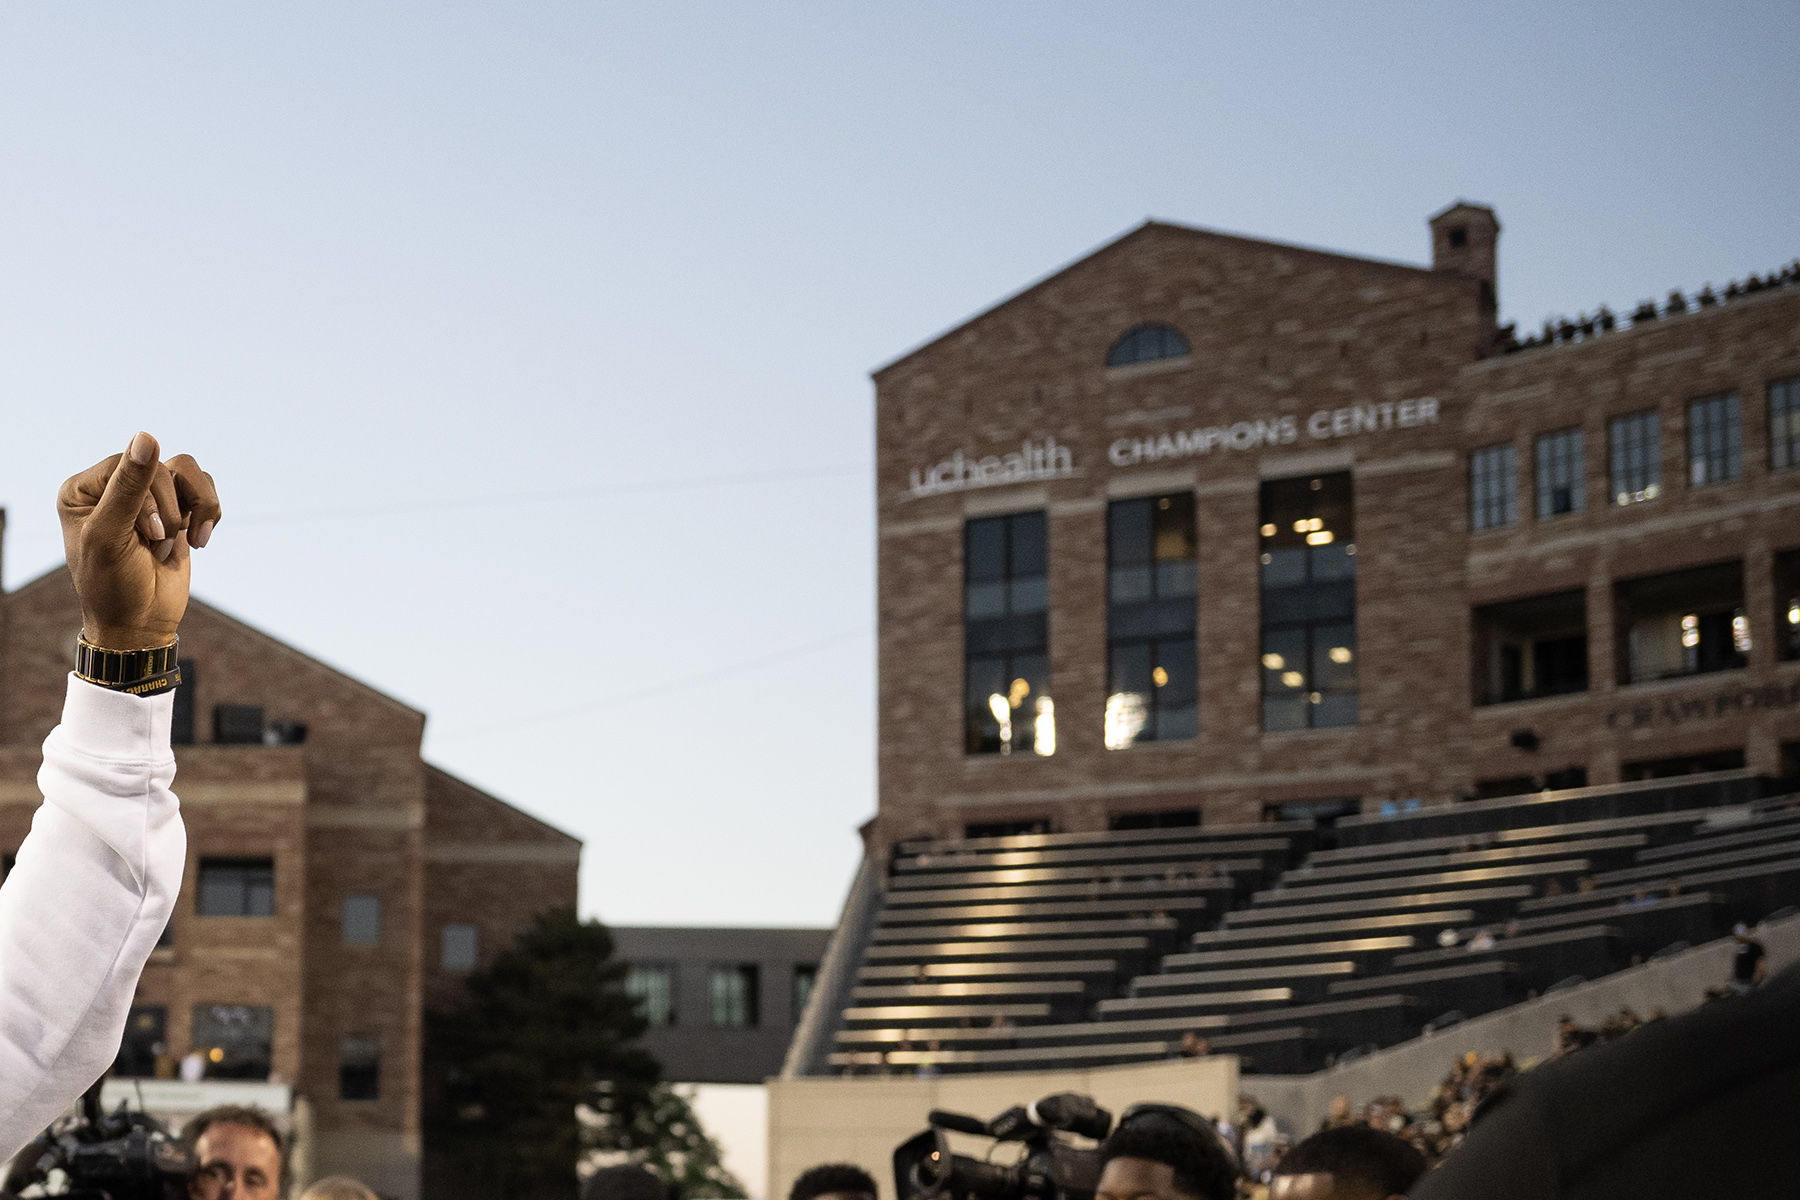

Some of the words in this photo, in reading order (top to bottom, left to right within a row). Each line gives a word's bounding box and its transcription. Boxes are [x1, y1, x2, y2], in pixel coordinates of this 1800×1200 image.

[1106, 416, 1297, 467] CHAMPIONS
[1306, 397, 1440, 440] CENTER
[121, 678, 167, 694] CHARAC
